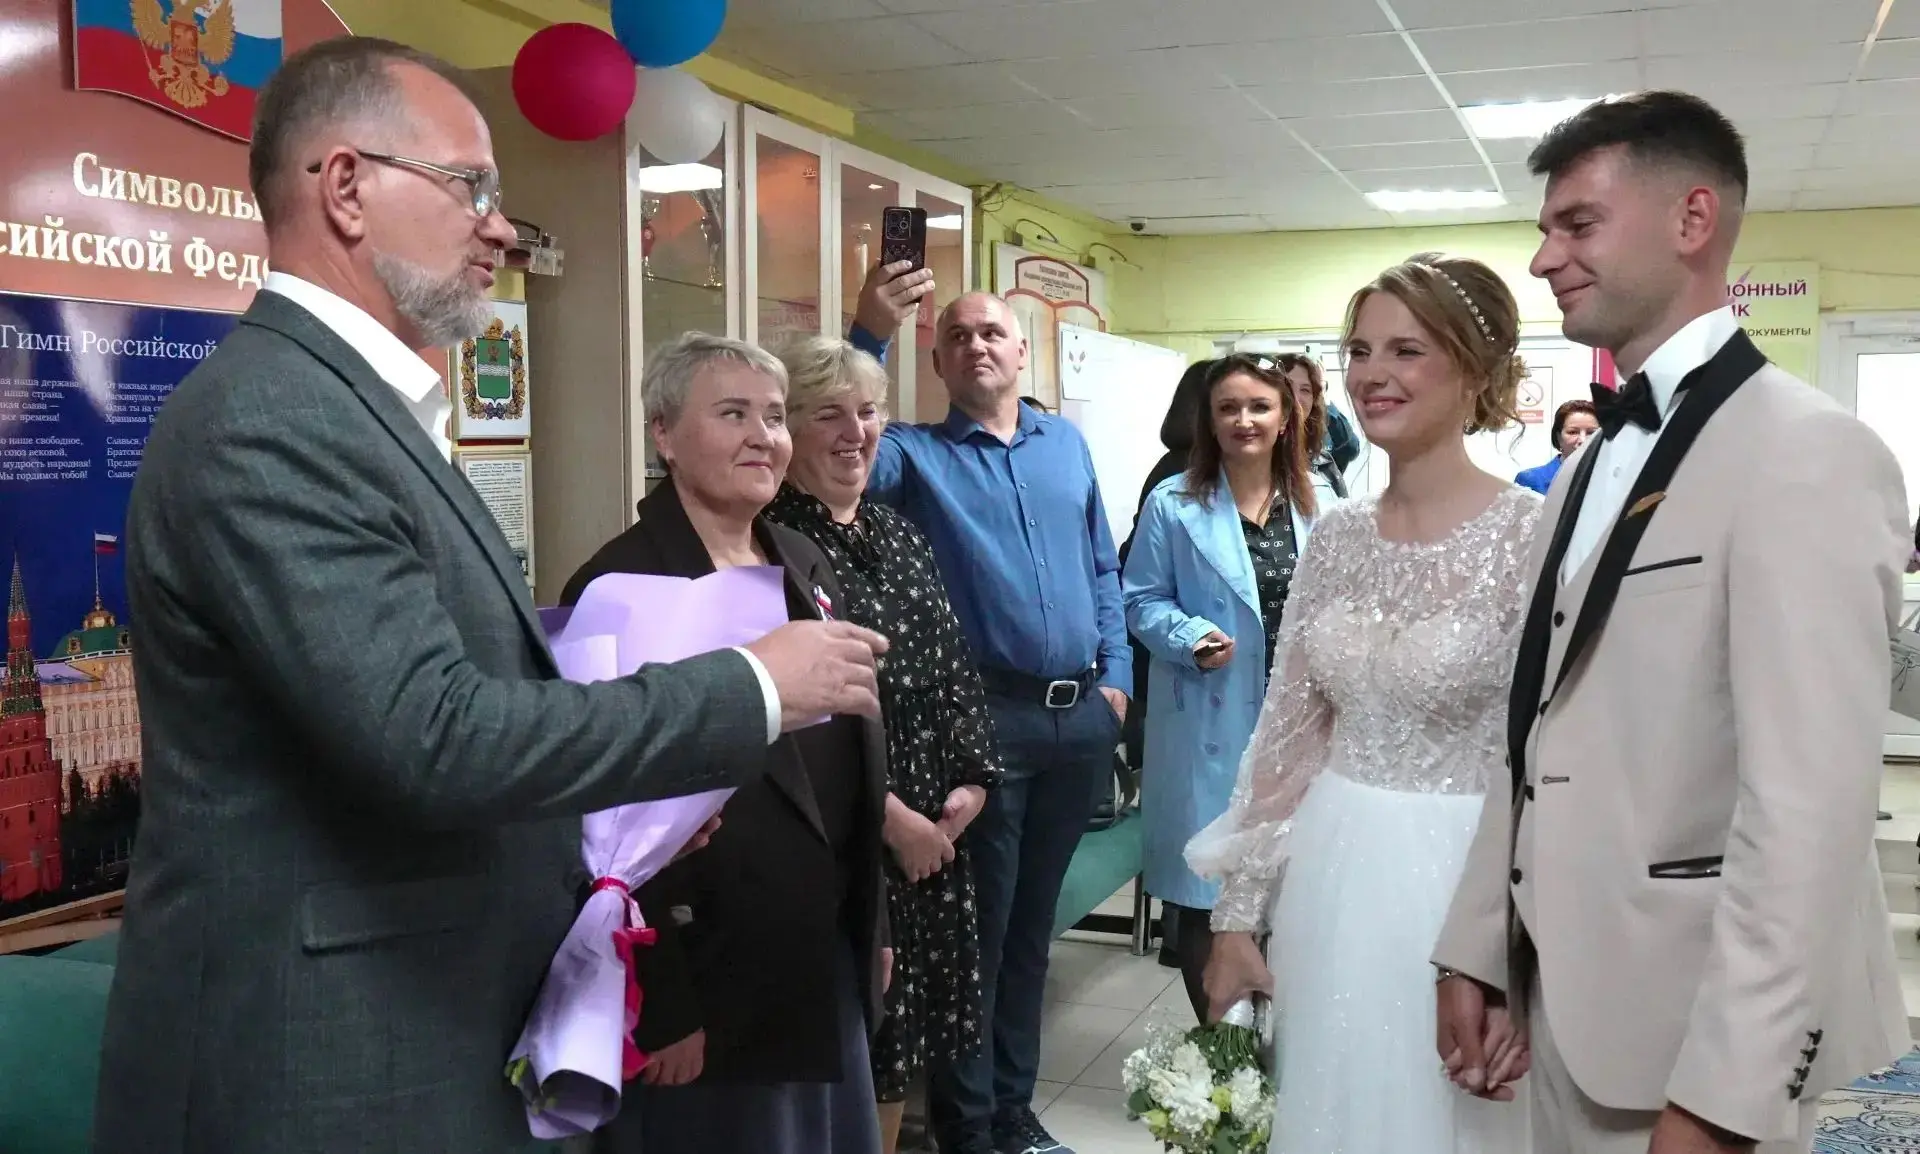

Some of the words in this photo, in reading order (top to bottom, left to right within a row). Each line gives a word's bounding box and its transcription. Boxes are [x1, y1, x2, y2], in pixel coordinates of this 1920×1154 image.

[1744, 327, 1812, 337] ОКУМЕНТЫ
[0, 324, 72, 352] Гимн
[20, 412, 60, 423] времена!
[35, 435, 84, 446] свободное,
[4, 449, 27, 457] союз
[3, 461, 46, 470] мудрость
[47, 458, 92, 469] народная!
[16, 473, 59, 481] гордимся
[60, 470, 88, 479] тобой!
